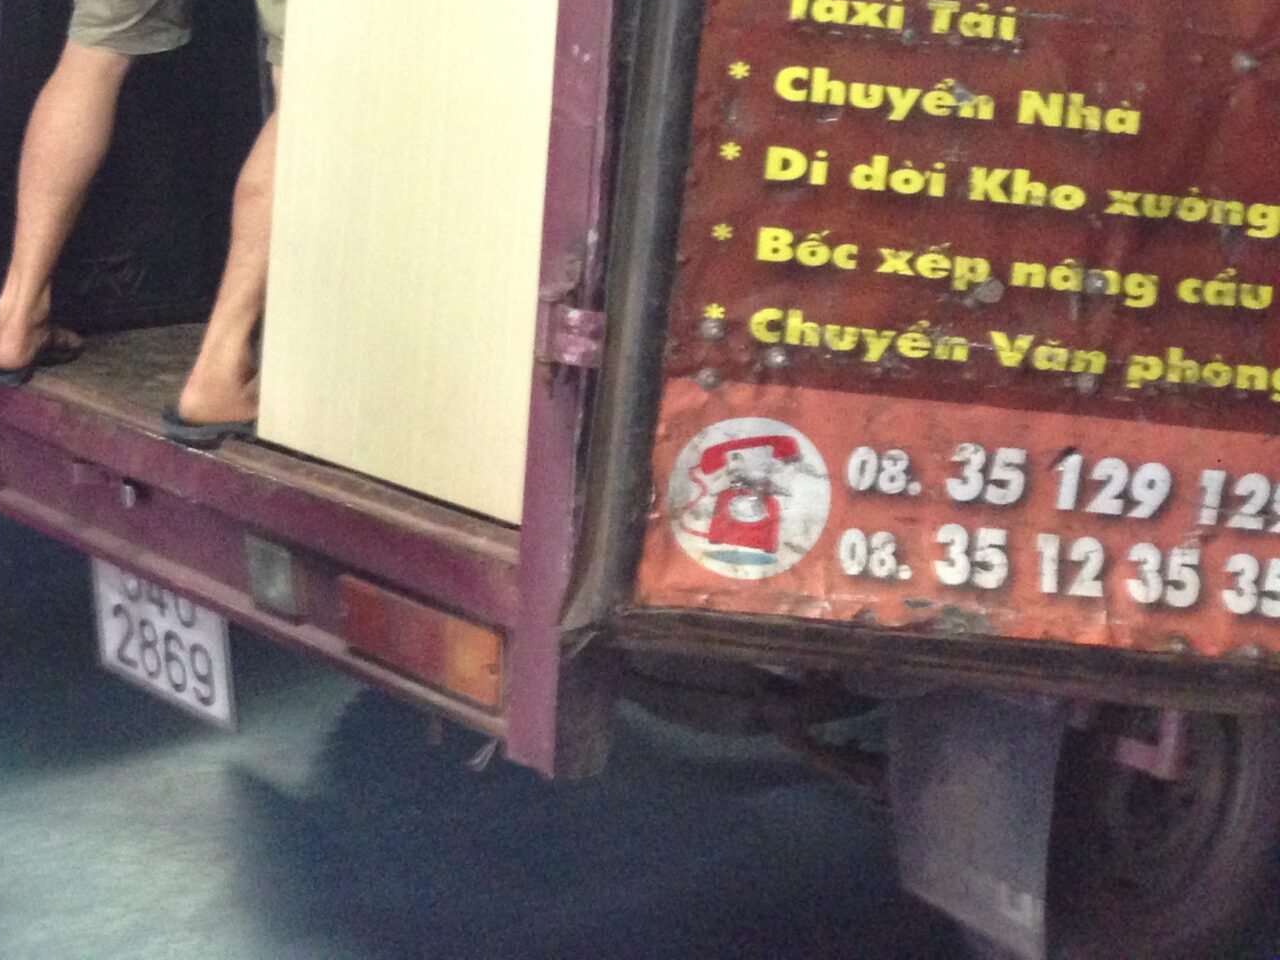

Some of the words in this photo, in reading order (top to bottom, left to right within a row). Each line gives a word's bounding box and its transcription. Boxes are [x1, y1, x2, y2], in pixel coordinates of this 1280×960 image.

[764, 145, 829, 186] Di
[968, 166, 1087, 211] Kho
[756, 226, 860, 270] Bốc
[847, 446, 921, 495] 08.
[945, 442, 1028, 505] 35
[1055, 453, 1172, 519] 129
[1198, 469, 1280, 533] 12
[838, 527, 913, 580] 08.
[933, 523, 1009, 590] 35
[1036, 533, 1105, 598] 12
[1126, 542, 1201, 608] 35
[112, 603, 216, 707] 2869
